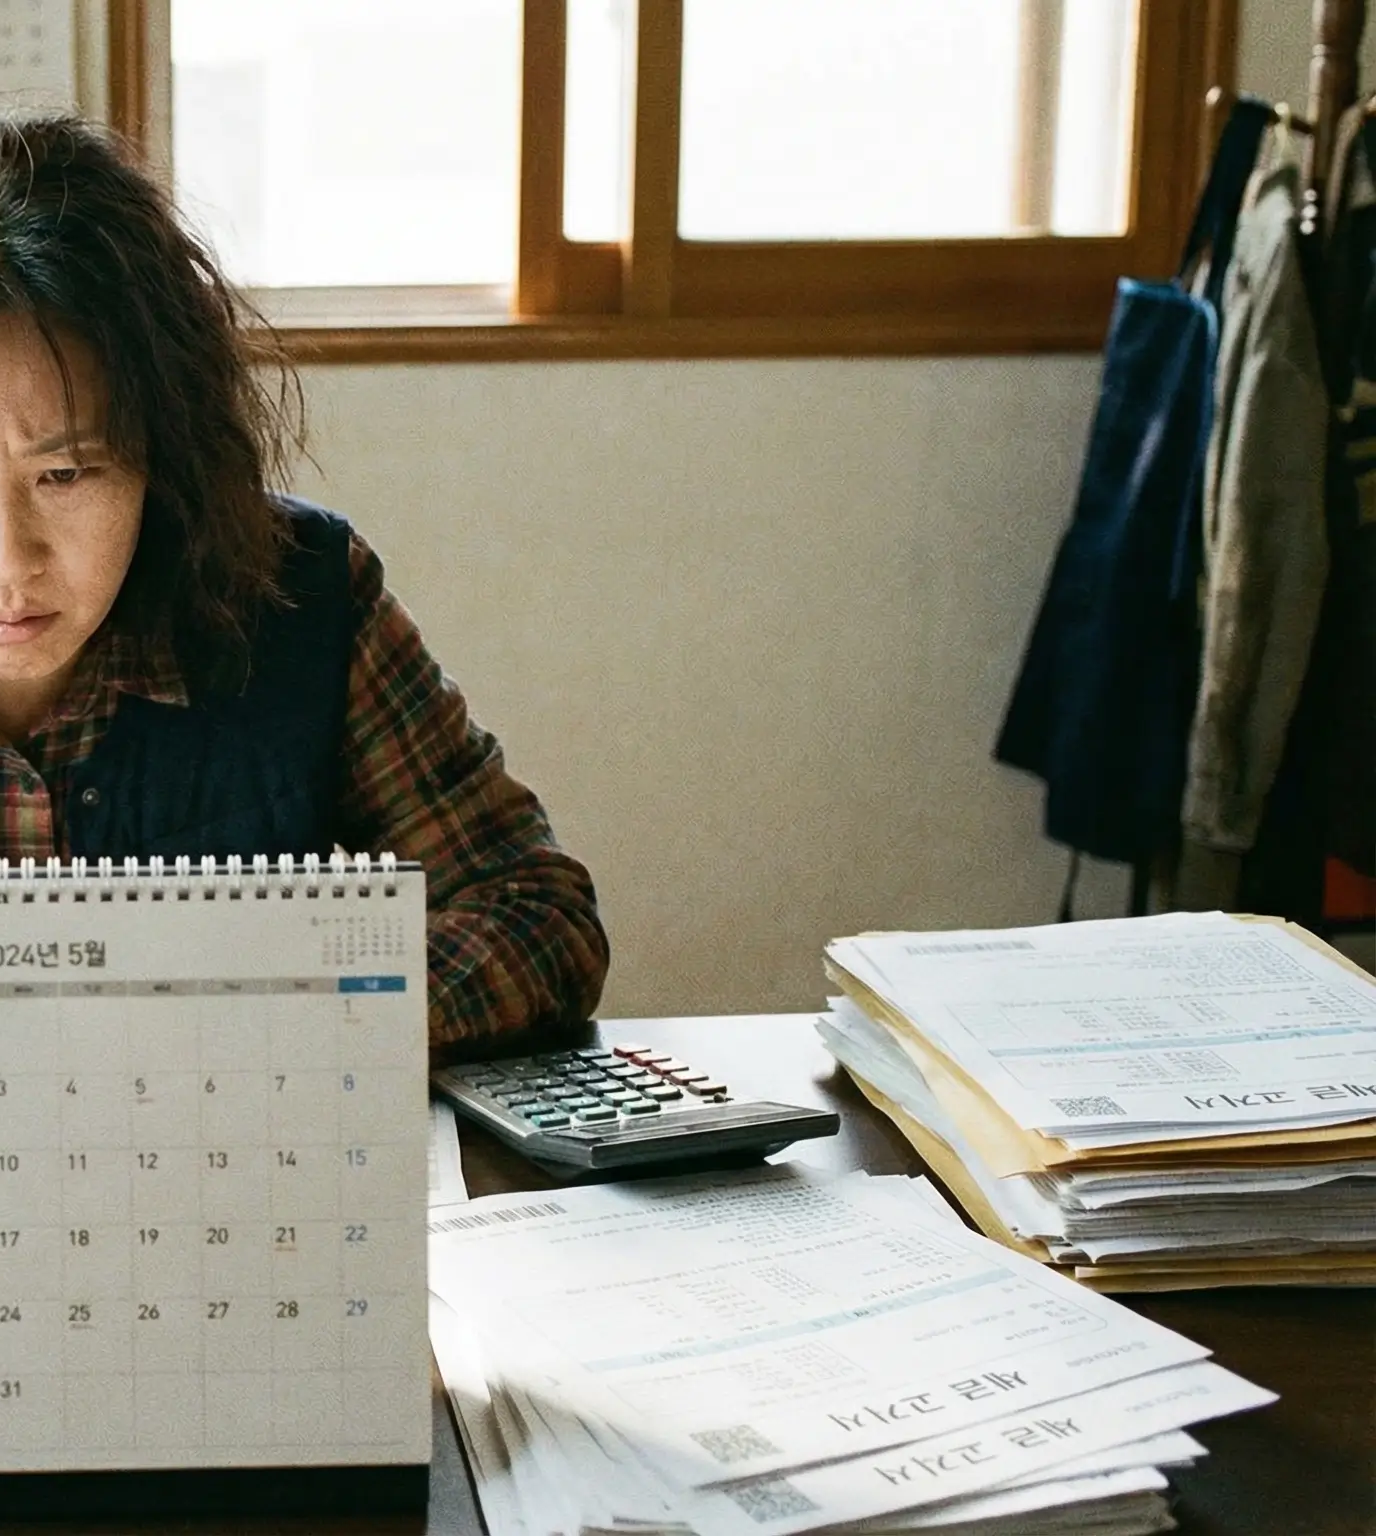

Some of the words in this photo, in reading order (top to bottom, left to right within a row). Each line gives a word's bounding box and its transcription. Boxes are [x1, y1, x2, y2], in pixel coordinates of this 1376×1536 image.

[67, 941, 107, 968] 5월
[345, 999, 351, 1014] 1
[66, 1080, 77, 1095] 4
[135, 1078, 146, 1095] 5
[205, 1078, 216, 1094] 6
[275, 1075, 286, 1092] 7
[344, 1074, 354, 1091] 8
[68, 1154, 87, 1171] 11
[138, 1153, 158, 1169] 12
[208, 1152, 228, 1169] 13
[276, 1151, 297, 1167] 14
[346, 1149, 366, 1166] 15
[0, 1231, 20, 1248] 17
[69, 1230, 89, 1246] 18
[139, 1229, 159, 1245] 19
[206, 1228, 229, 1244] 20
[276, 1227, 297, 1243] 21
[345, 1225, 367, 1242] 22
[0, 1306, 21, 1322] 24
[68, 1305, 91, 1322] 25
[138, 1304, 160, 1320] 26
[207, 1302, 229, 1319] 27
[276, 1301, 299, 1318] 28
[346, 1300, 368, 1316] 29
[0, 1381, 21, 1398] 31
[948, 1370, 1028, 1401] 세금
